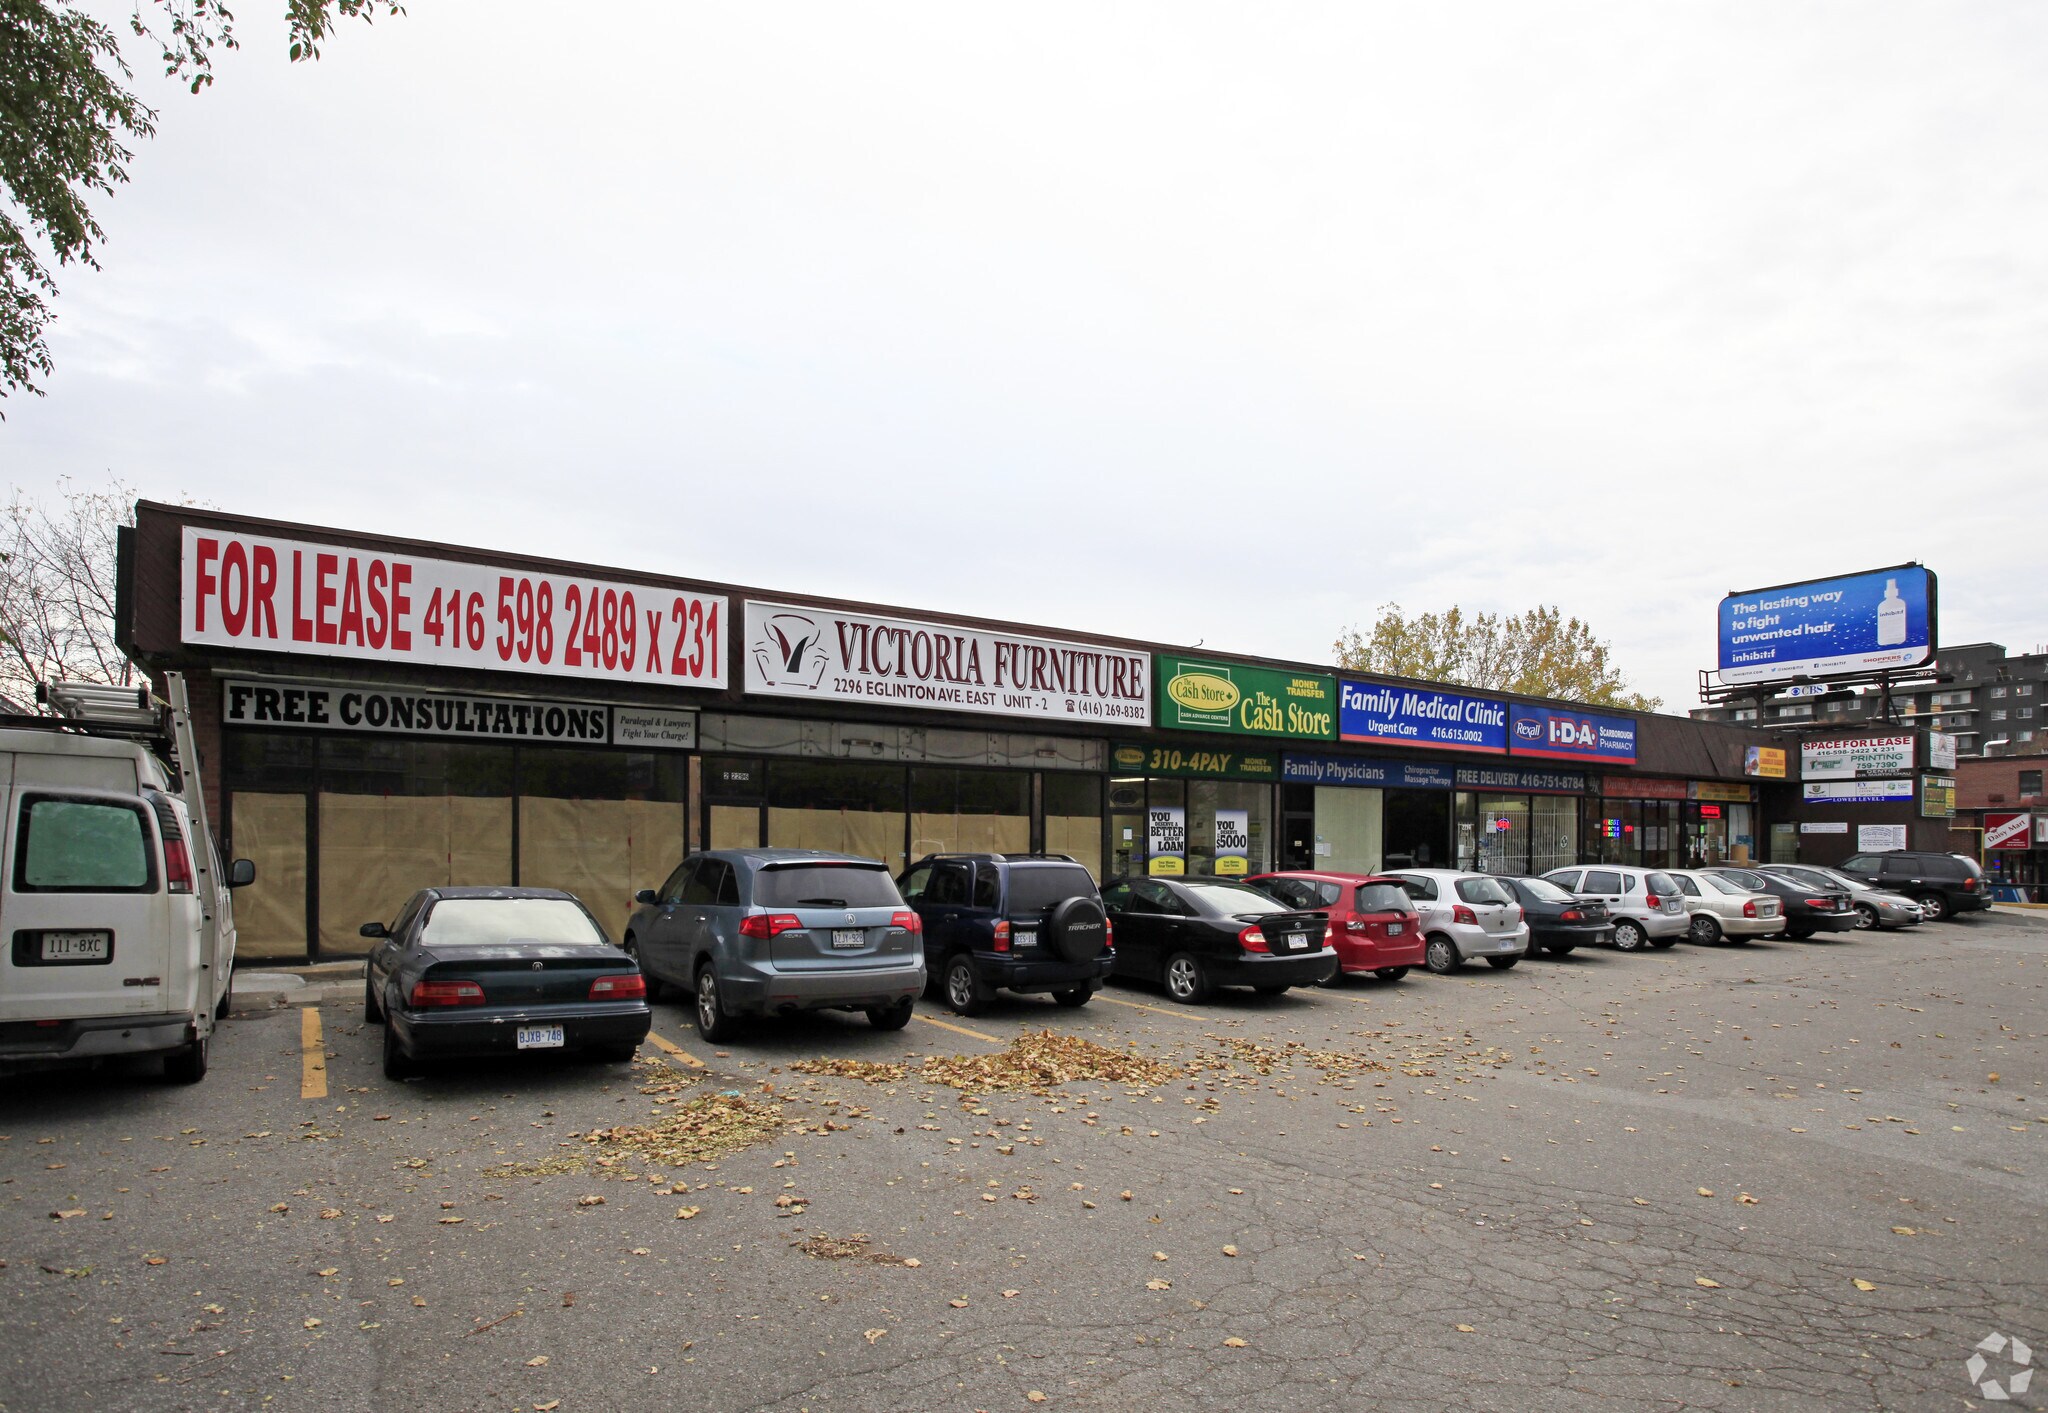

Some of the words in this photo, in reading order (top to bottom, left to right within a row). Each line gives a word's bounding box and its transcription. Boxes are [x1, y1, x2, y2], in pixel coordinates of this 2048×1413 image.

[195, 537, 278, 639] FOR
[292, 549, 412, 651] LEASE
[423, 586, 484, 651] 416
[496, 576, 554, 664] 598
[565, 583, 636, 673] 2489
[671, 596, 718, 679] 231
[1731, 603, 1757, 615] The
[1760, 596, 1808, 611] lasting
[1811, 591, 1843, 603] way
[1732, 619, 1746, 630] to
[1747, 614, 1780, 630] fight
[1732, 624, 1802, 645] unwanted
[1804, 621, 1835, 634] hair
[835, 620, 985, 687] VICTORIA
[994, 640, 1146, 702] FURNITURE
[1863, 655, 1901, 663] SHOPPERS
[1175, 681, 1199, 700] Cash
[1201, 684, 1225, 702] Store
[1291, 679, 1319, 689] MONEY
[1801, 685, 1823, 696] CBS
[834, 678, 862, 694] 2296
[866, 681, 936, 702] EGLINTON
[937, 686, 965, 703] AVE.
[966, 691, 997, 707] EAST
[1003, 694, 1033, 711] UNIT
[1042, 697, 1048, 711] 2
[1256, 691, 1271, 707] The
[1286, 687, 1325, 699] TRANSFER
[229, 685, 330, 724] FREE
[339, 692, 605, 739] CONSULTATIONS
[1078, 700, 1103, 718] (416)
[1105, 702, 1145, 720] 269-8382
[1341, 685, 1399, 720] Family
[1401, 693, 1463, 722] Medical
[1464, 701, 1505, 727] Clinic
[620, 715, 654, 728] Paralegal
[663, 719, 692, 729] Lawyers
[1241, 697, 1284, 732] Cash
[1288, 703, 1331, 735] Store
[622, 728, 641, 740] Fight
[643, 729, 658, 739] Your
[660, 730, 689, 742] Charge!
[1368, 719, 1397, 735] Urgent
[1398, 723, 1418, 736] Care
[1431, 726, 1483, 743] 416.615.0002
[1517, 722, 1541, 738] Rexall
[1600, 726, 1633, 740] SCARBOROUGH
[1600, 738, 1633, 751] PHARMACY
[1803, 740, 1841, 751] SPACE
[1843, 740, 1867, 749] FOR
[1870, 737, 1911, 747] LEASE
[1150, 749, 1231, 772] 310-4PAY
[1244, 757, 1267, 766] MONEY
[1850, 752, 1904, 763] PRINTING
[1239, 764, 1272, 773] TRANSFER
[1284, 759, 1324, 780] Family
[1327, 762, 1385, 782] Physicians
[1404, 765, 1440, 776] Chiropractor
[1856, 761, 1898, 770] 759-7390
[1404, 774, 1429, 785] Massage
[1429, 776, 1452, 787] Therapy
[1456, 769, 1478, 784] FREE
[1480, 771, 1520, 787] DELIVERY
[1521, 774, 1585, 790] 416-751-8784
[1150, 811, 1170, 821] YOU
[1151, 826, 1184, 836] BETTER
[1216, 821, 1234, 830] YOU
[1987, 829, 2008, 842] Daisy
[2008, 820, 2026, 832] Mart
[1157, 841, 1184, 851] LOAN
[1216, 834, 1247, 849] $5000
[1068, 922, 1101, 931] TRACKER
[50, 939, 70, 953] 111
[79, 938, 101, 952] 8XC
